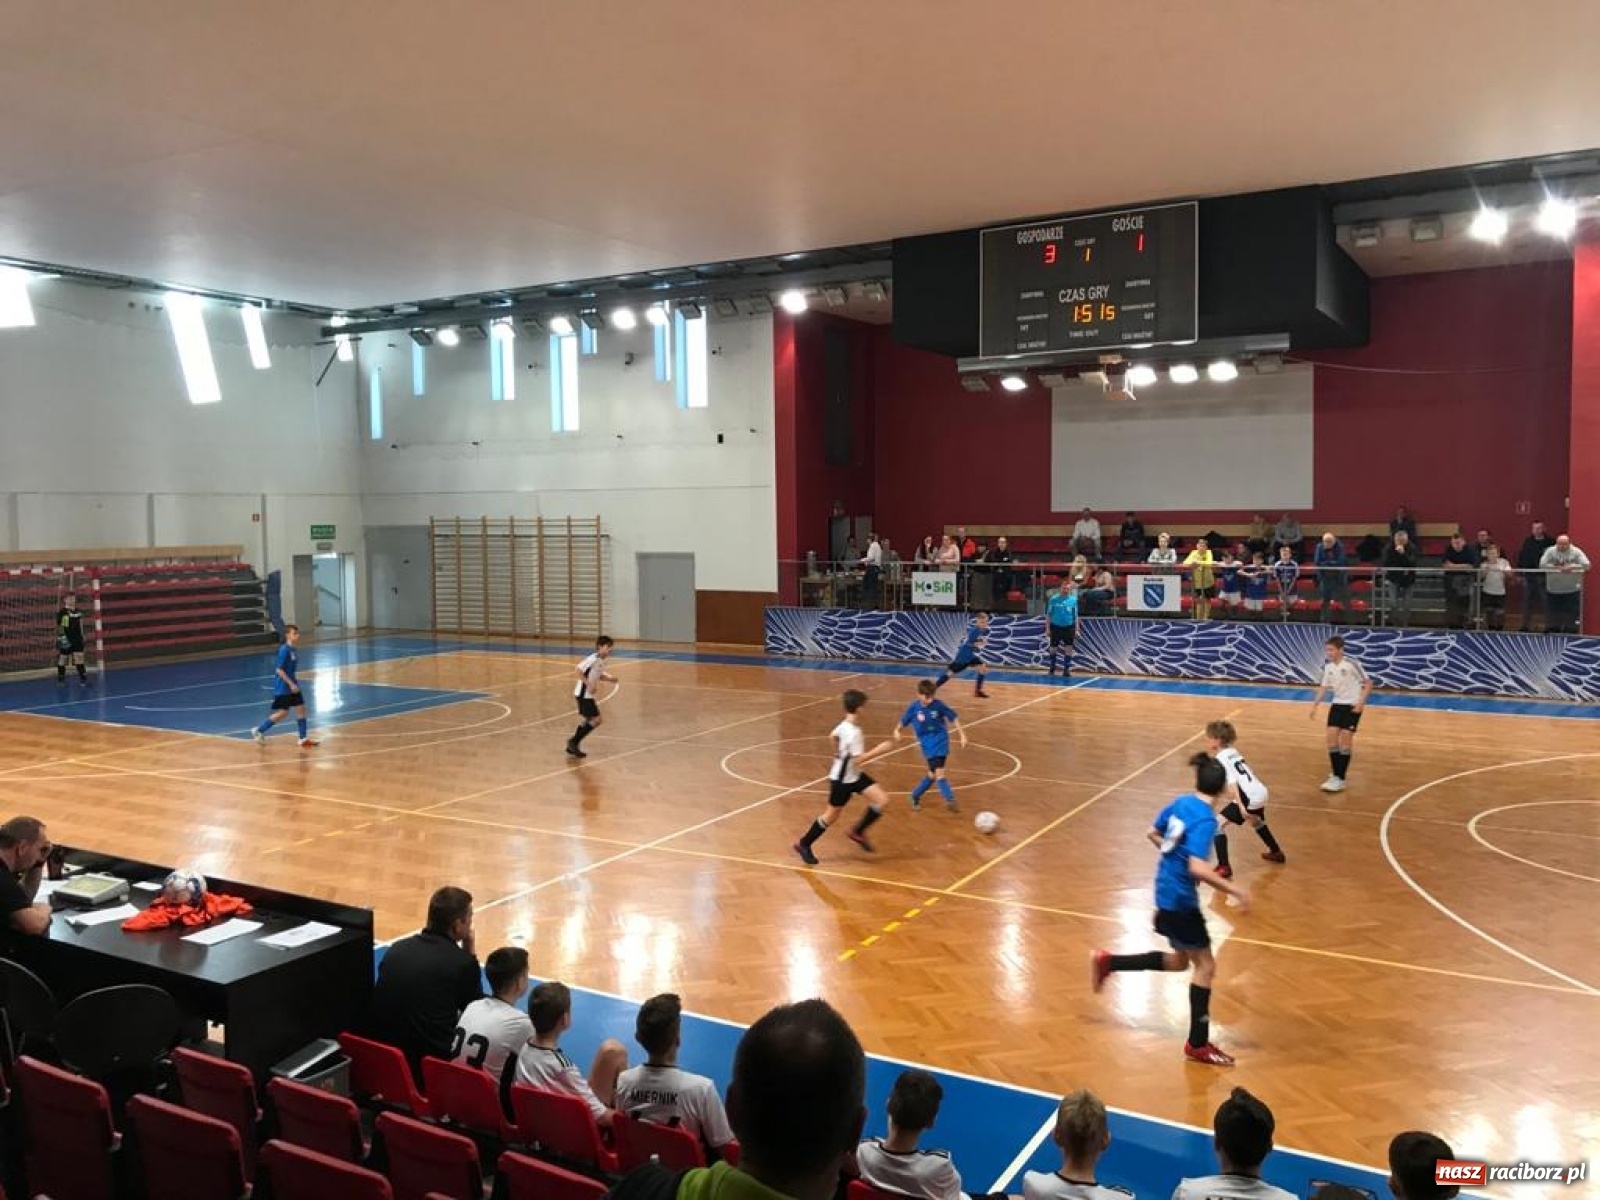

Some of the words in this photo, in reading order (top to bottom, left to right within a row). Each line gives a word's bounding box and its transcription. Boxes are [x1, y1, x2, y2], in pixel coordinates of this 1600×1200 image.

[1112, 214, 1145, 232] GOŚCIE
[1016, 226, 1064, 245] GOSPODARZE
[1044, 244, 1057, 264] 3
[1084, 246, 1092, 262] 1
[1059, 287, 1085, 304] CZAS
[1088, 285, 1110, 300] GRY
[630, 1090, 679, 1106] MIERNIK
